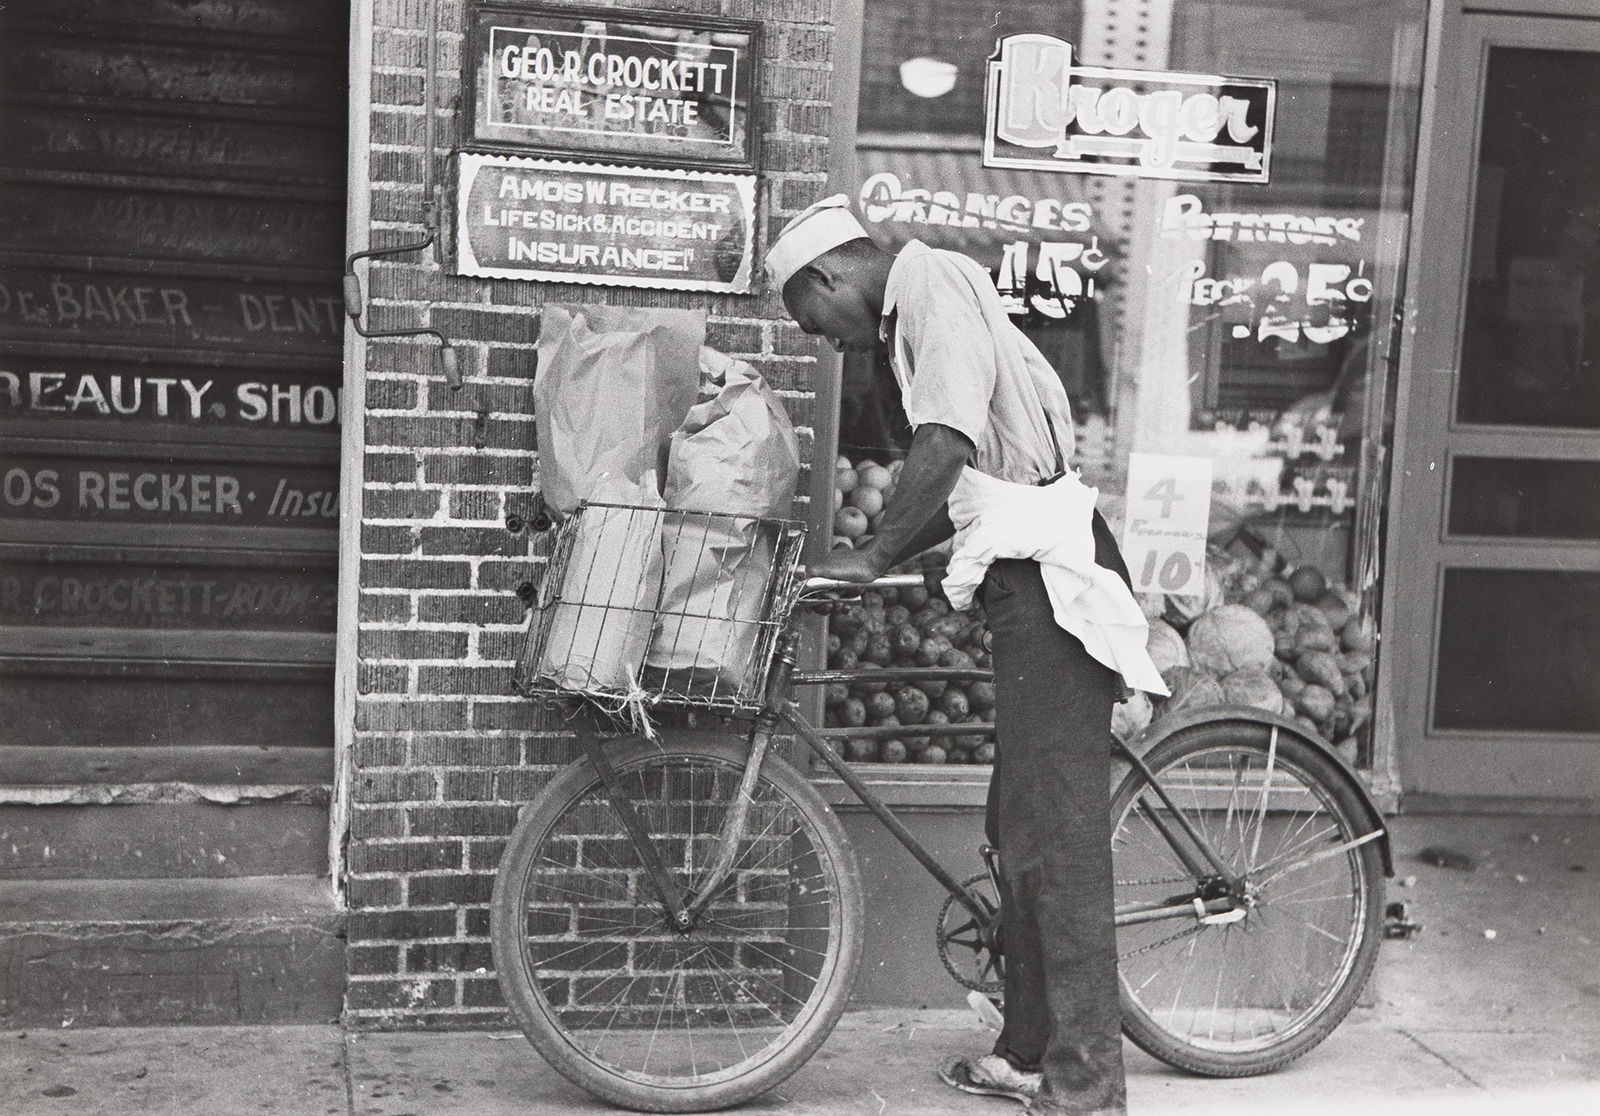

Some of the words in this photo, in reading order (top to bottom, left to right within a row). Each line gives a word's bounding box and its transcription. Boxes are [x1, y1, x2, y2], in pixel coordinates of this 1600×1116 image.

[501, 45, 561, 83] GEO.
[588, 53, 728, 94] CROCKETT
[526, 87, 588, 117] REAL
[604, 93, 699, 126] ESTATE
[1006, 42, 1259, 169] Kroger
[498, 176, 584, 204] AMOS
[609, 182, 732, 214] RECKER
[859, 172, 1093, 233] ORANGES
[483, 205, 539, 228] LIFE
[611, 214, 722, 241] ACCIDENT
[52, 282, 194, 326] BAKER
[236, 382, 343, 425] SHO
[1142, 476, 1185, 519] 4
